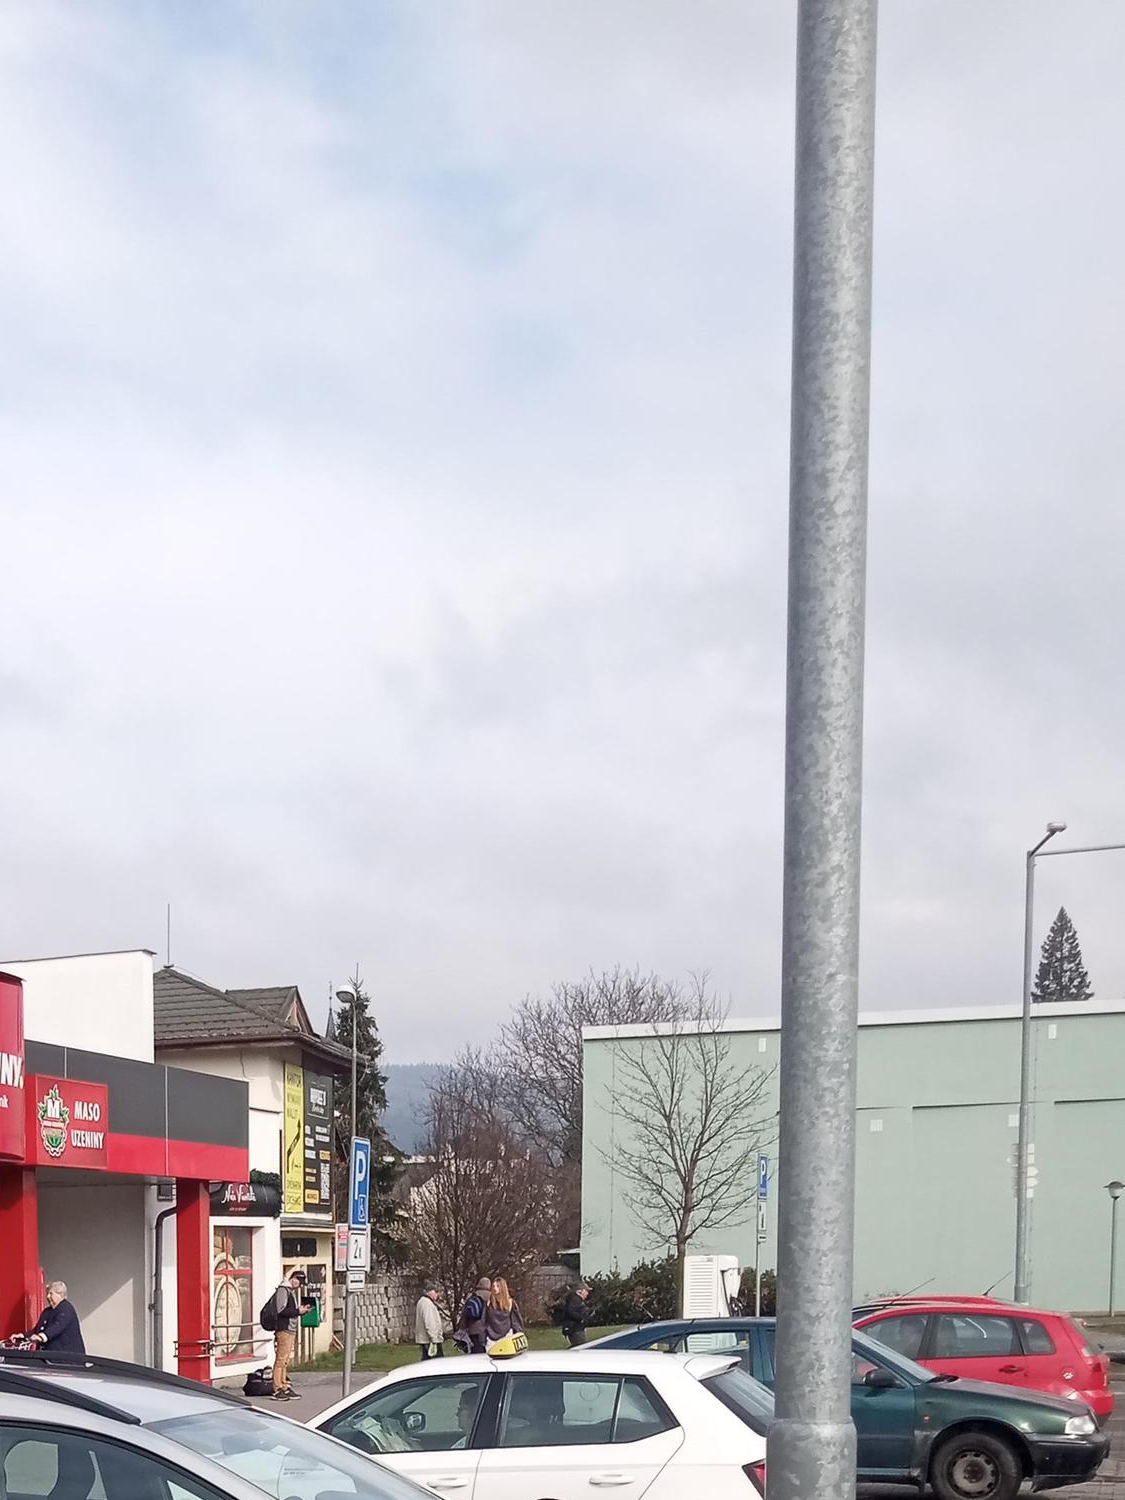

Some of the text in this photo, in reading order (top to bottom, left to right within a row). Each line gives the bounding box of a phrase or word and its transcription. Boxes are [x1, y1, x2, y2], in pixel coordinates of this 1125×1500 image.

[74, 1101, 101, 1122] MASO
[71, 1129, 104, 1150] UZENINY
[354, 1150, 367, 1201] P
[760, 1159, 766, 1185] P
[512, 1334, 529, 1352] TAXI
